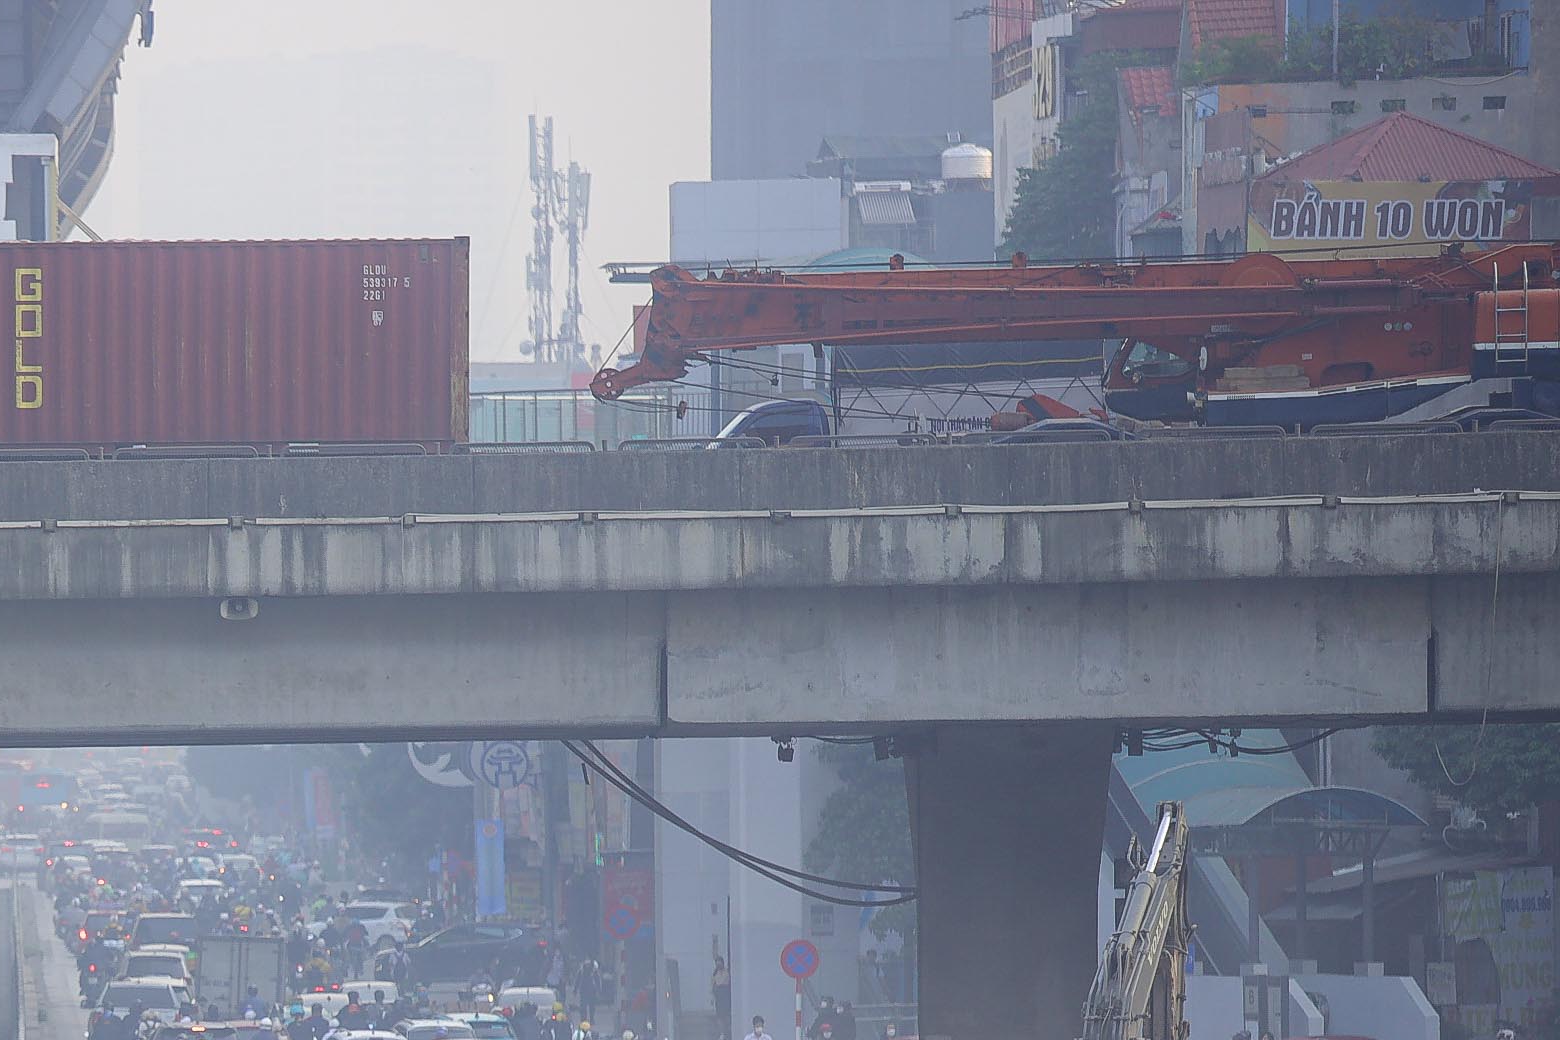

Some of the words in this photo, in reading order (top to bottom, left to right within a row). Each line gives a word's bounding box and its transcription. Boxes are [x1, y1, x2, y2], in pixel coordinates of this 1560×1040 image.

[1271, 190, 1366, 240] BÁNH
[1374, 201, 1414, 240] 10
[1422, 199, 1505, 241] WON
[363, 264, 387, 275] GLDU
[363, 277, 398, 288] 539317
[403, 276, 411, 288] 5
[363, 290, 385, 301] 22G1
[15, 268, 43, 409] GOLD
[1137, 900, 1169, 965] VOLVO
